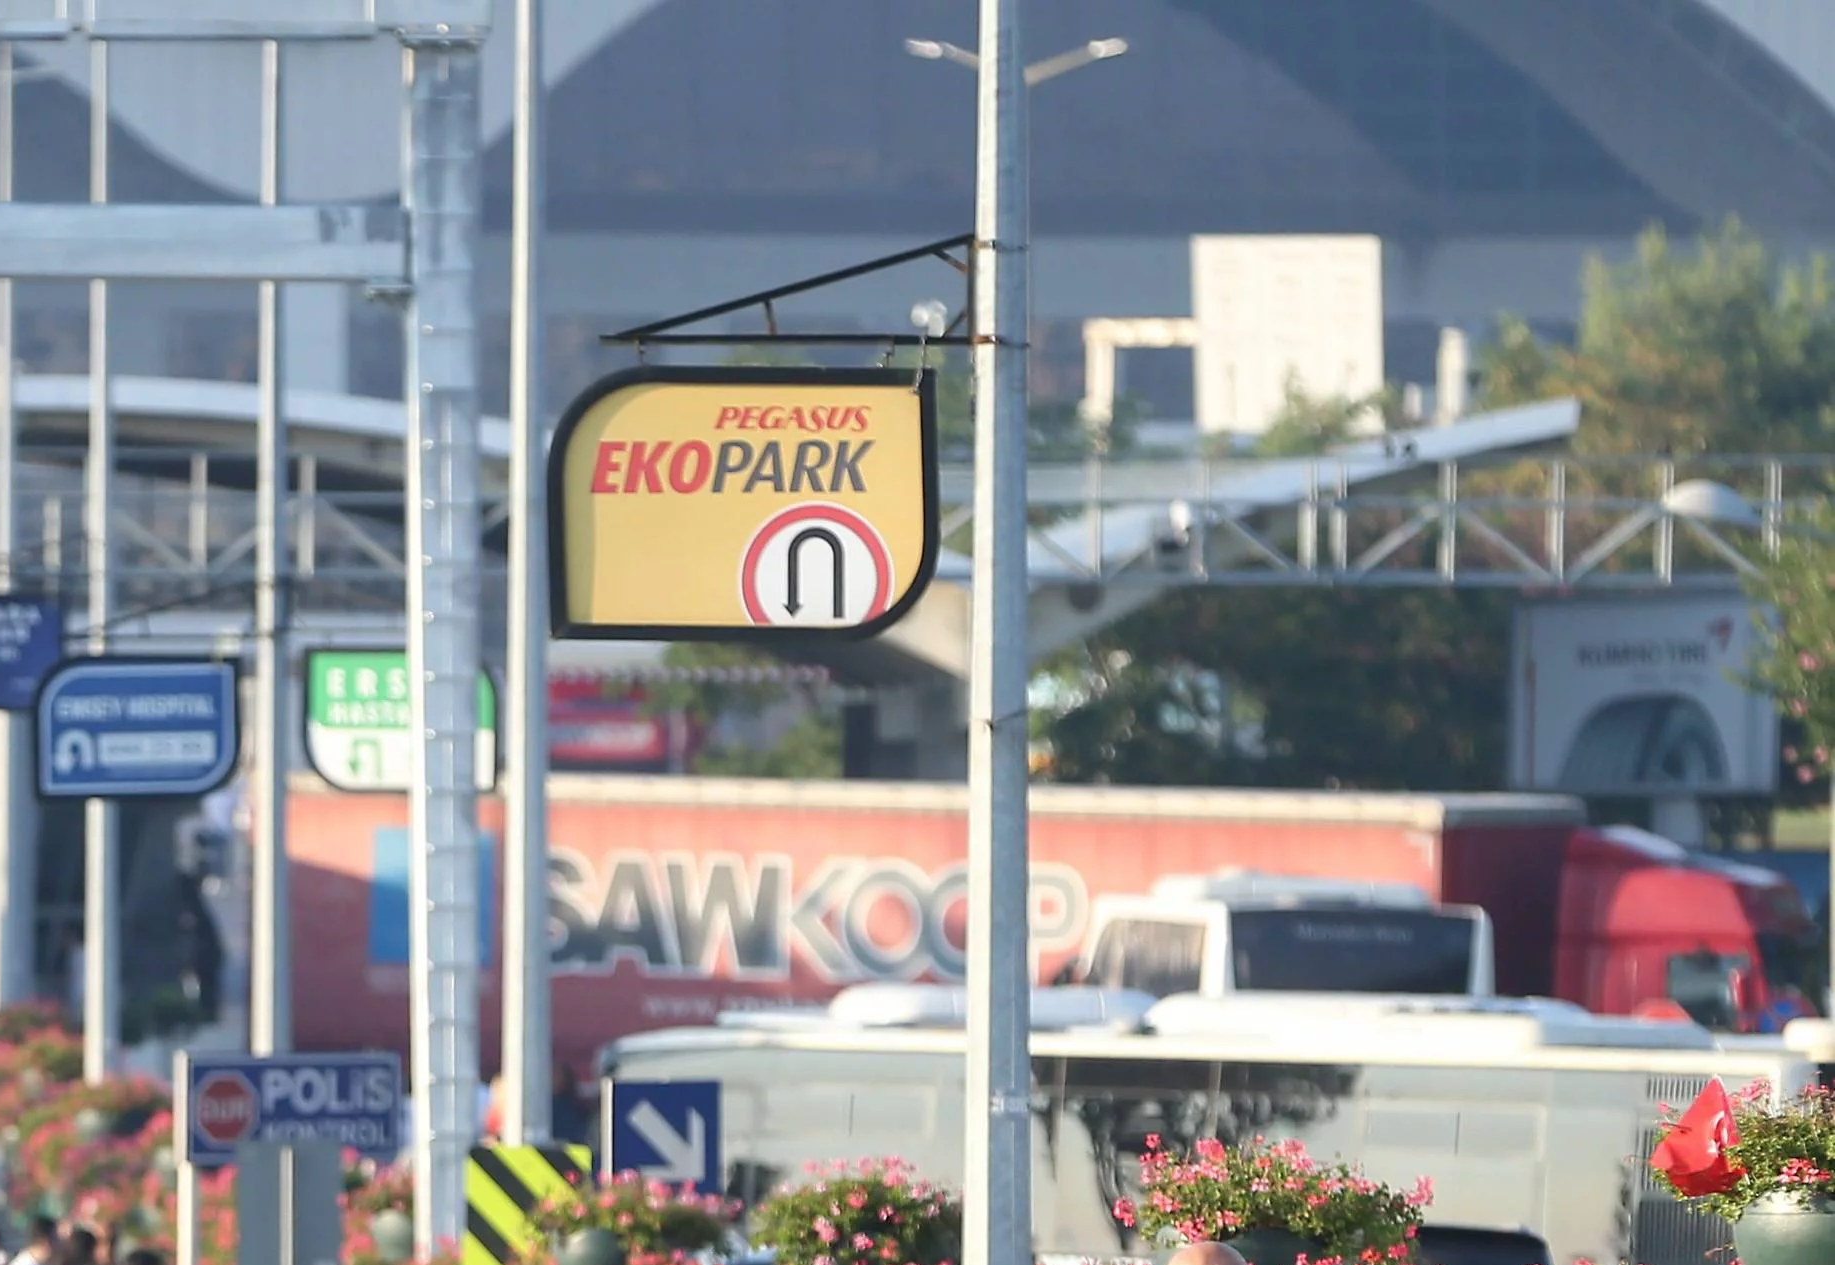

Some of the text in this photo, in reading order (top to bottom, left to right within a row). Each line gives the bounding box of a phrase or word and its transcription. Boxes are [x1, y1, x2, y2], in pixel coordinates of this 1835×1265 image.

[714, 405, 871, 432] PEGASUS
[590, 439, 877, 494] EKOPARK
[326, 668, 409, 699] ERS
